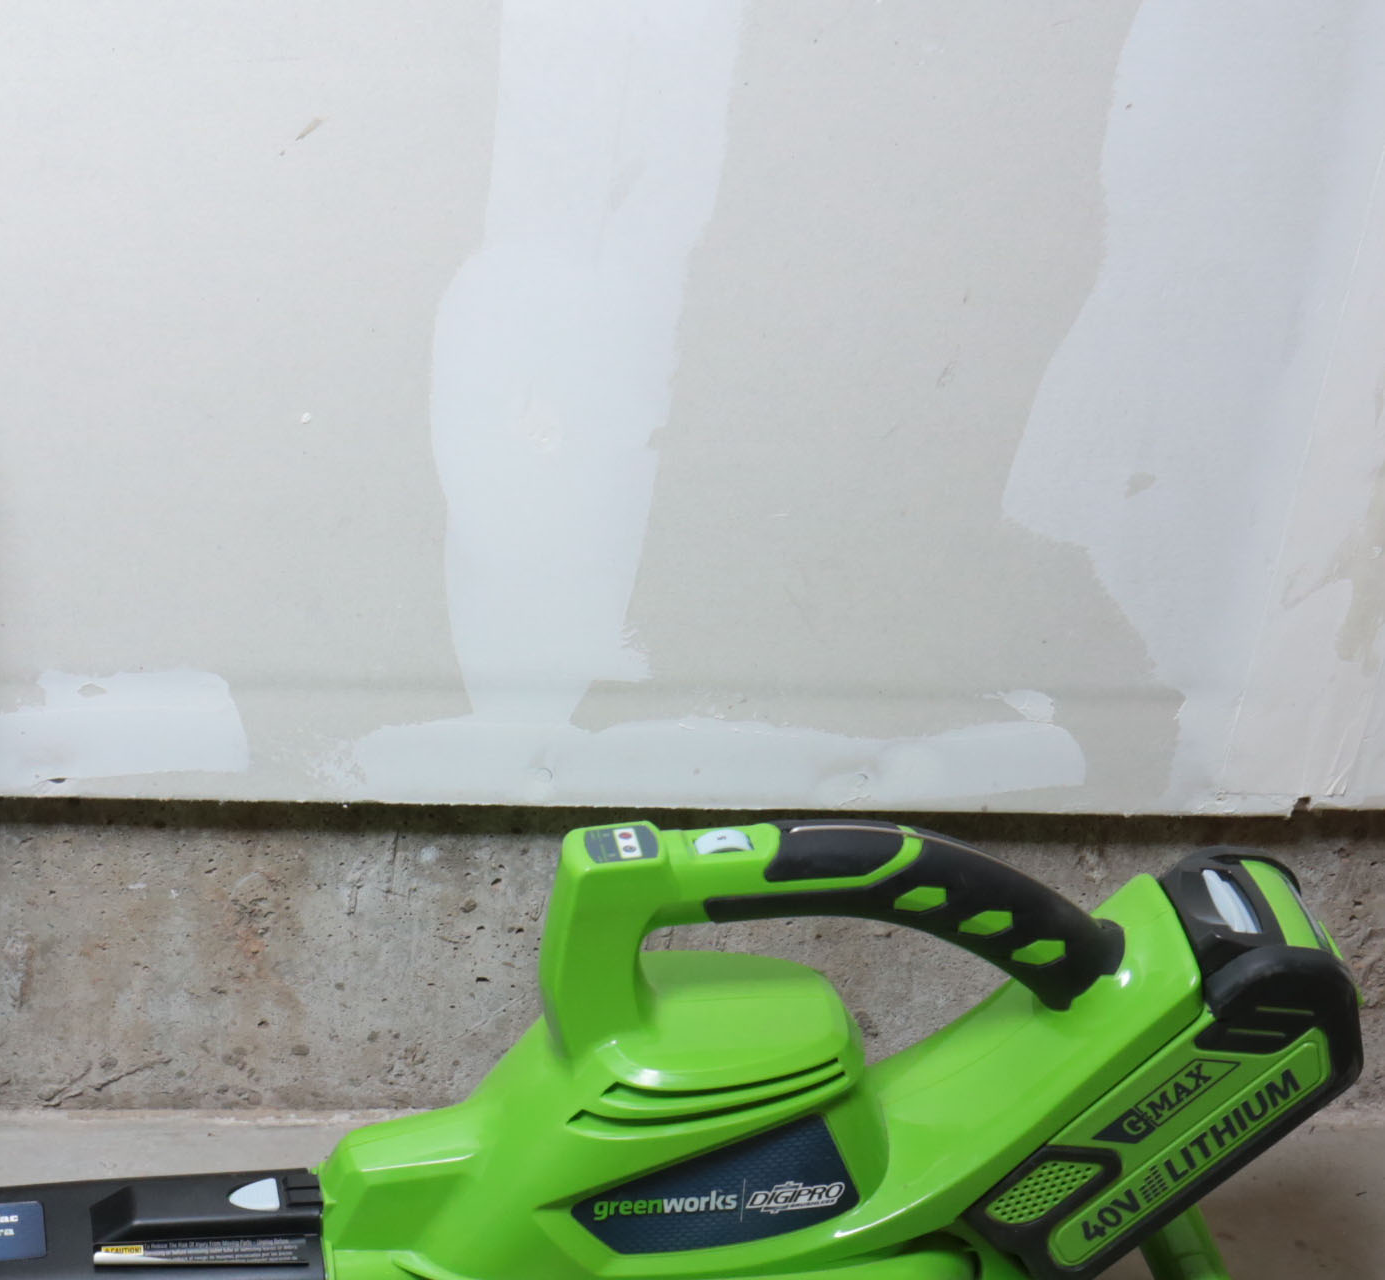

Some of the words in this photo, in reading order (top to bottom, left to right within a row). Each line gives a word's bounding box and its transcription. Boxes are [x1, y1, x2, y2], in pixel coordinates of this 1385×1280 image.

[593, 1190, 738, 1221] greenworks
[746, 1182, 845, 1208] DIGIPRO
[1080, 1188, 1141, 1241] 40V
[1164, 1068, 1301, 1182] LITHIUM
